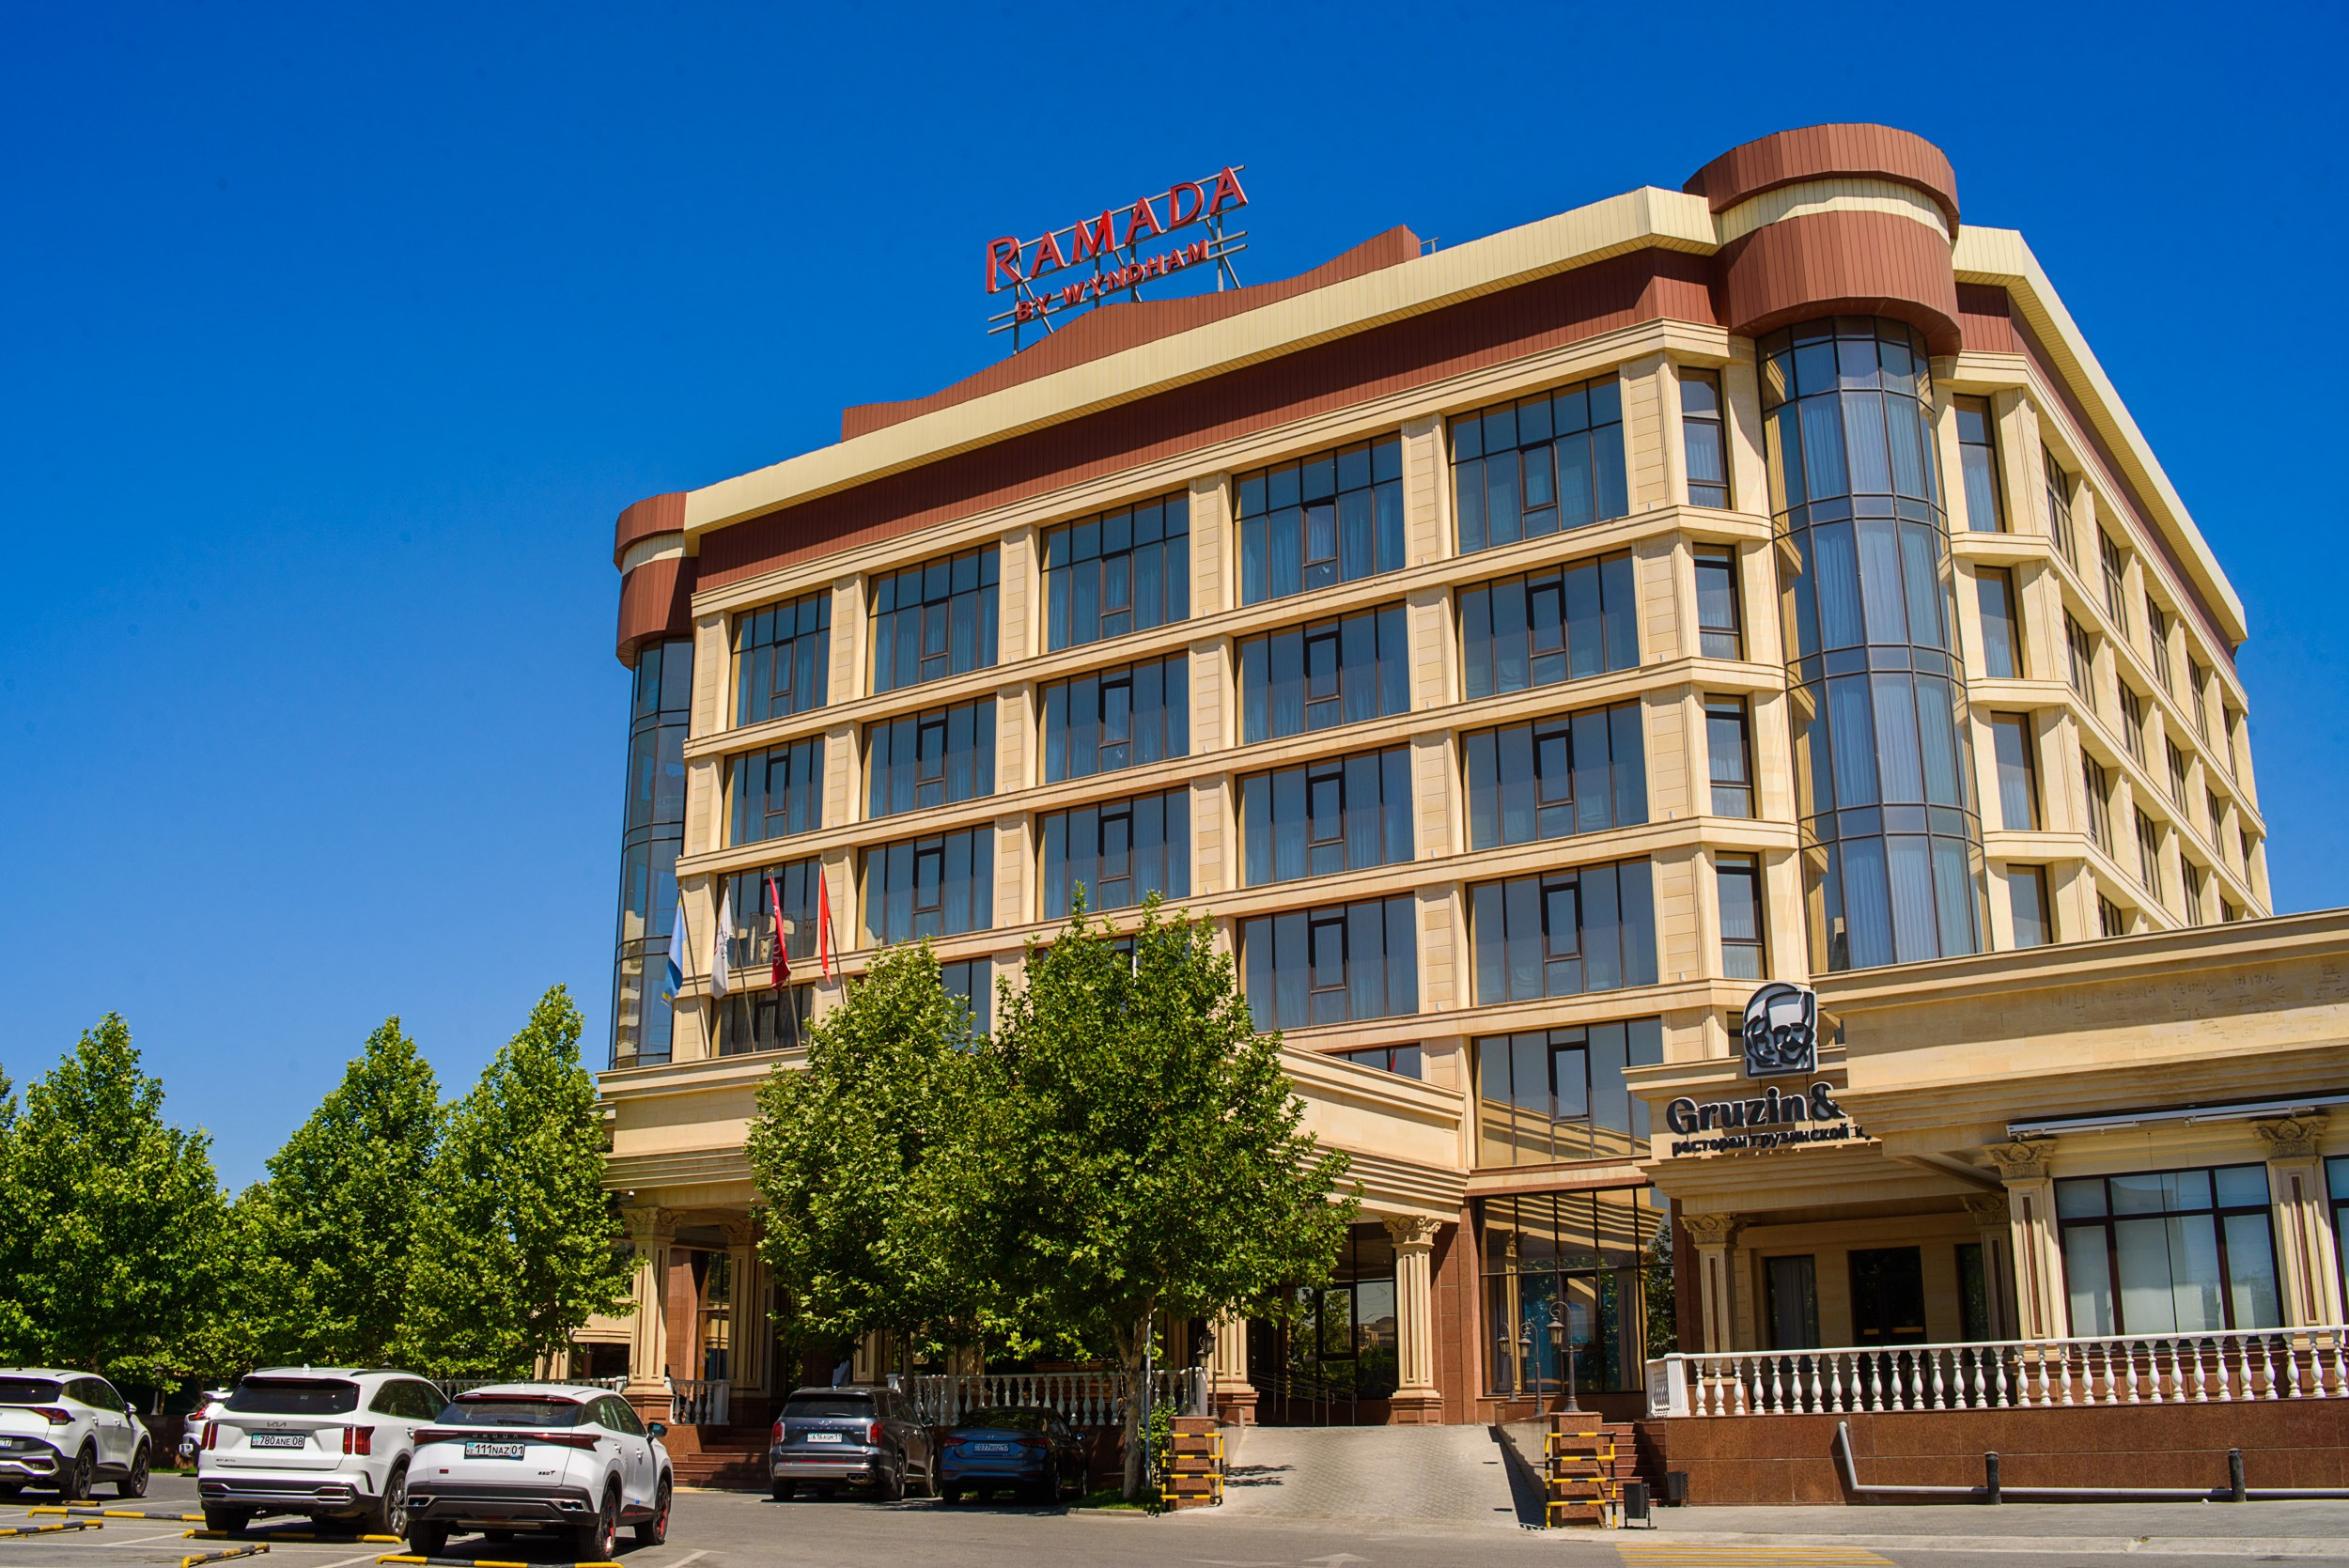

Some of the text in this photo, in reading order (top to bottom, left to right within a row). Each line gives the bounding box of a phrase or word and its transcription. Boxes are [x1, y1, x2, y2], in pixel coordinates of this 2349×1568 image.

[986, 166, 1249, 294] RAMADA
[1017, 239, 1210, 321] BY WYNDHAM
[1750, 1122, 1850, 1150] грузинской
